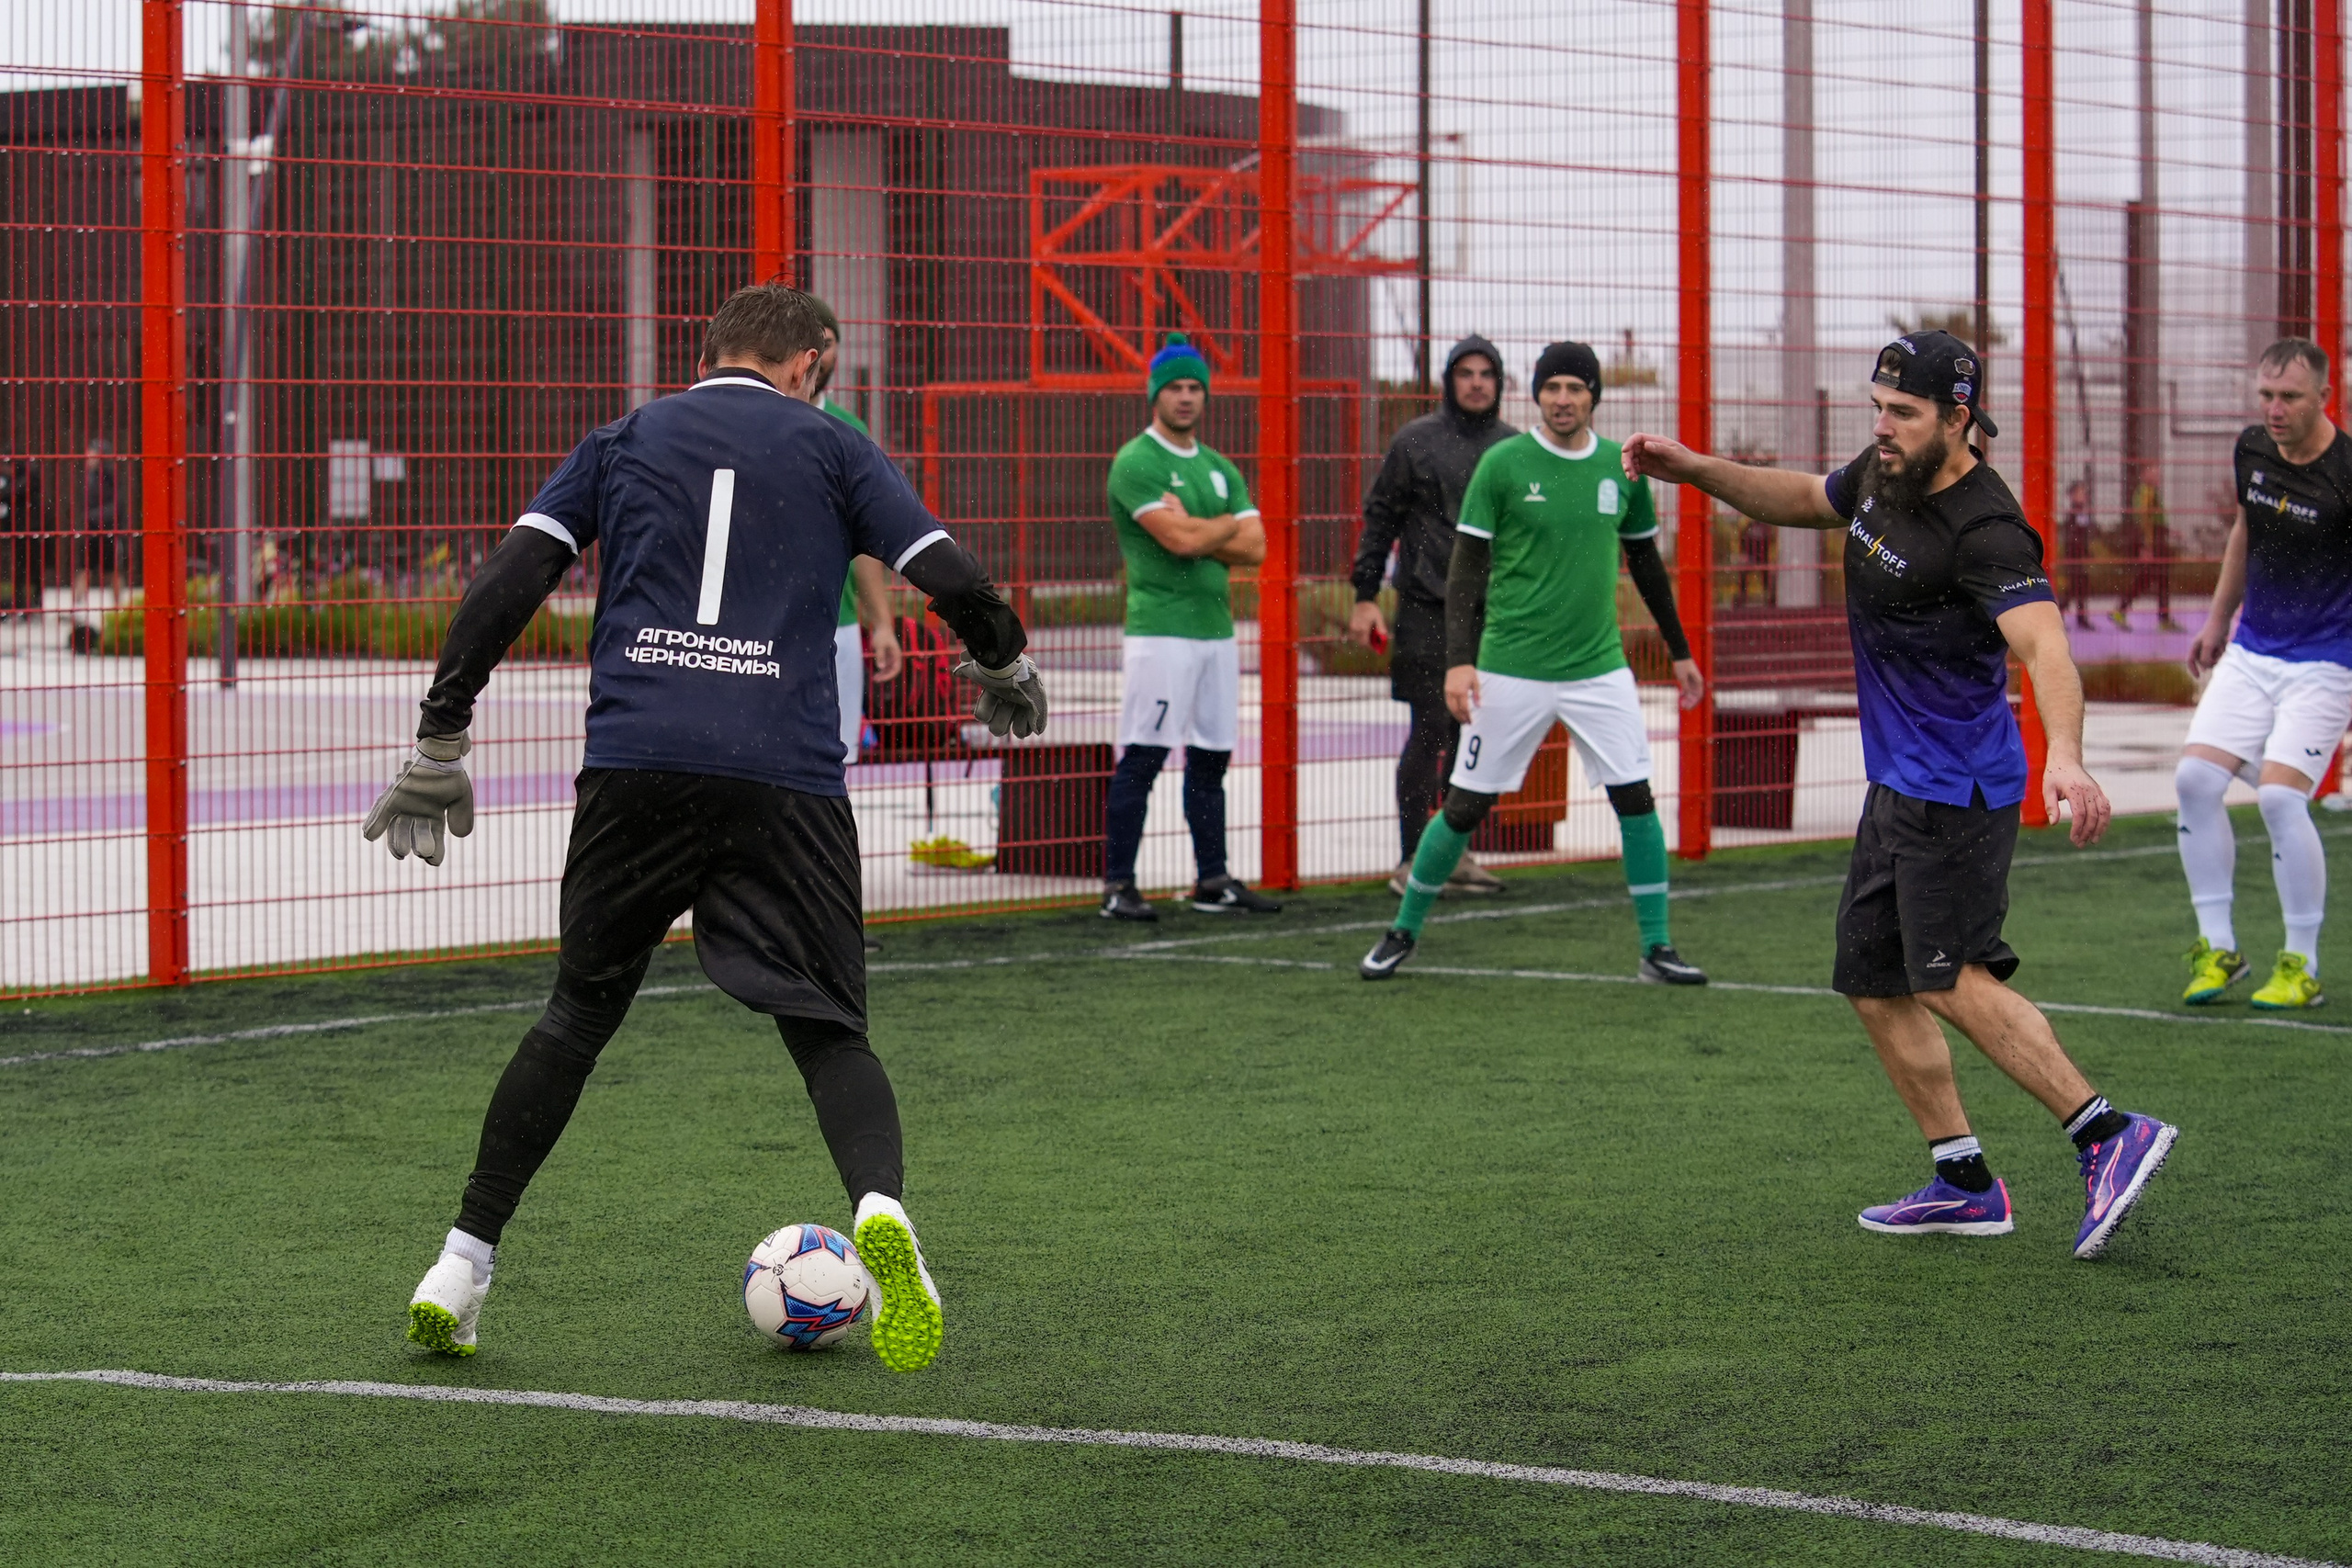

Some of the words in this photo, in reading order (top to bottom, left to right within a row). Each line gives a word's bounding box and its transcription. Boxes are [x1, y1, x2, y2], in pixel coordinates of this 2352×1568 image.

[696, 468, 735, 626] 1
[637, 627, 774, 657] АГРОНОМЫ
[625, 646, 781, 679] ЧЕРНОЗЕМЬЯ
[1155, 700, 1169, 731] 7
[1464, 735, 1481, 771] 9
